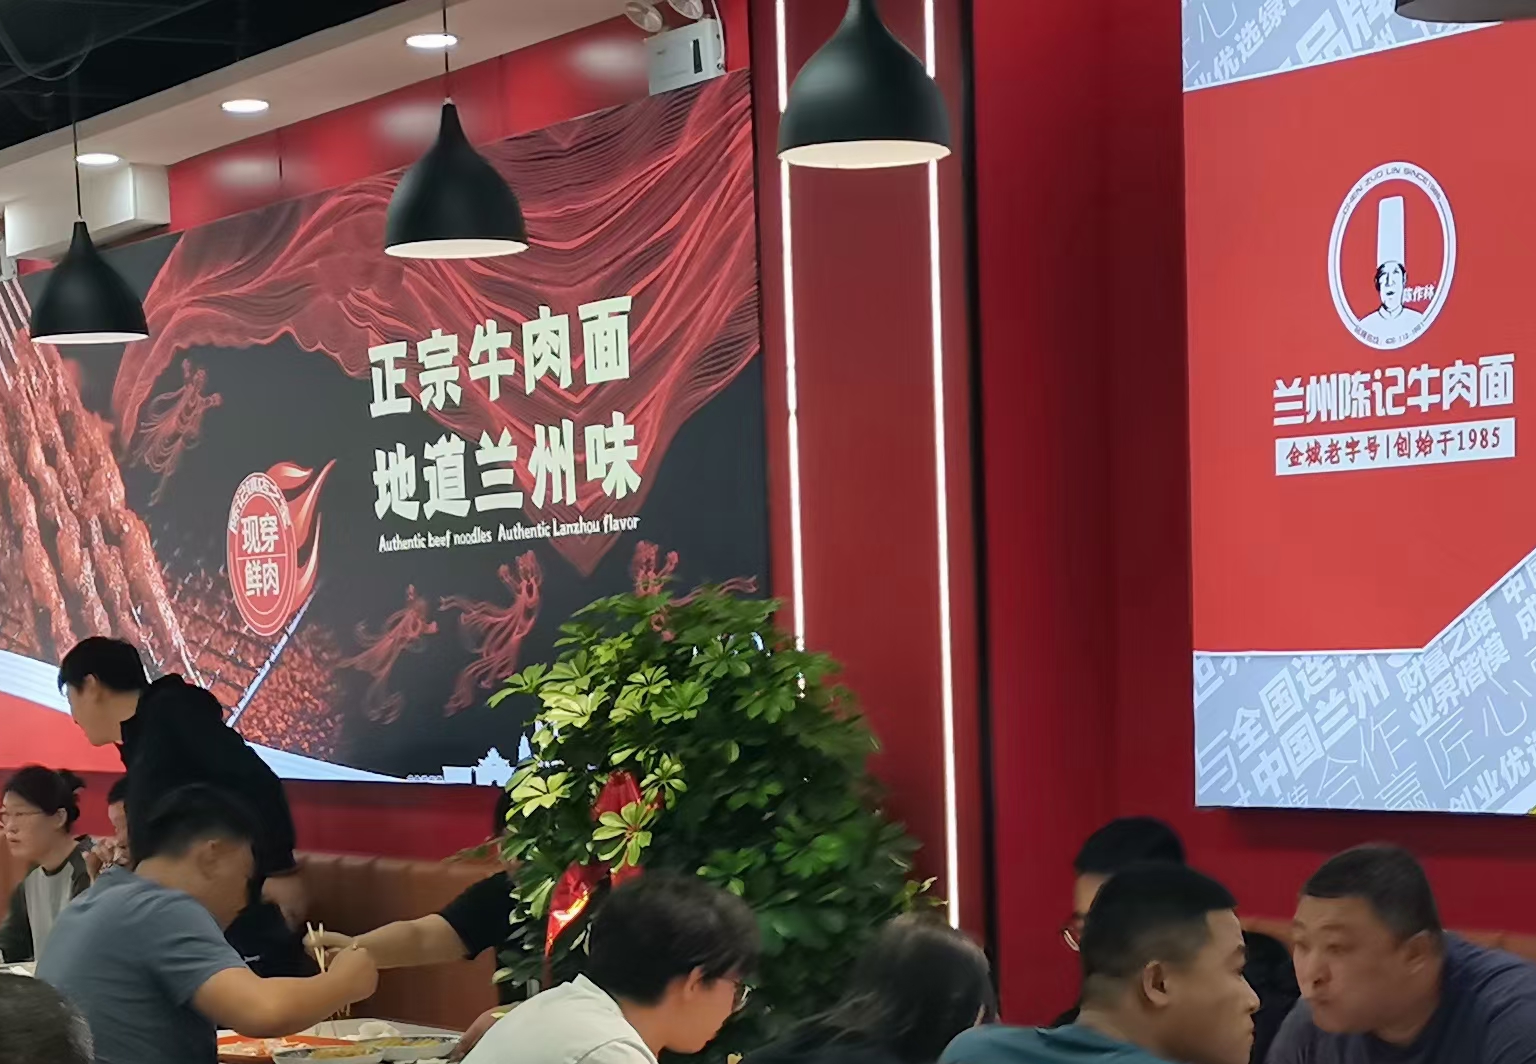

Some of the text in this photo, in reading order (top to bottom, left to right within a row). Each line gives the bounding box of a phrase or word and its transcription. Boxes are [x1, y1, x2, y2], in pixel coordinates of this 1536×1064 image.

[368, 295, 633, 418] 正宗牛肉面
[1273, 353, 1515, 427] 兰州陈记牛肉面
[372, 410, 642, 522] 地道兰州味
[240, 512, 280, 555] 现穿
[378, 512, 641, 553] Authentic beef noodles Authentic Lanzhou flavor
[244, 557, 281, 598] 鲜肉
[1230, 655, 1357, 763] 全国连
